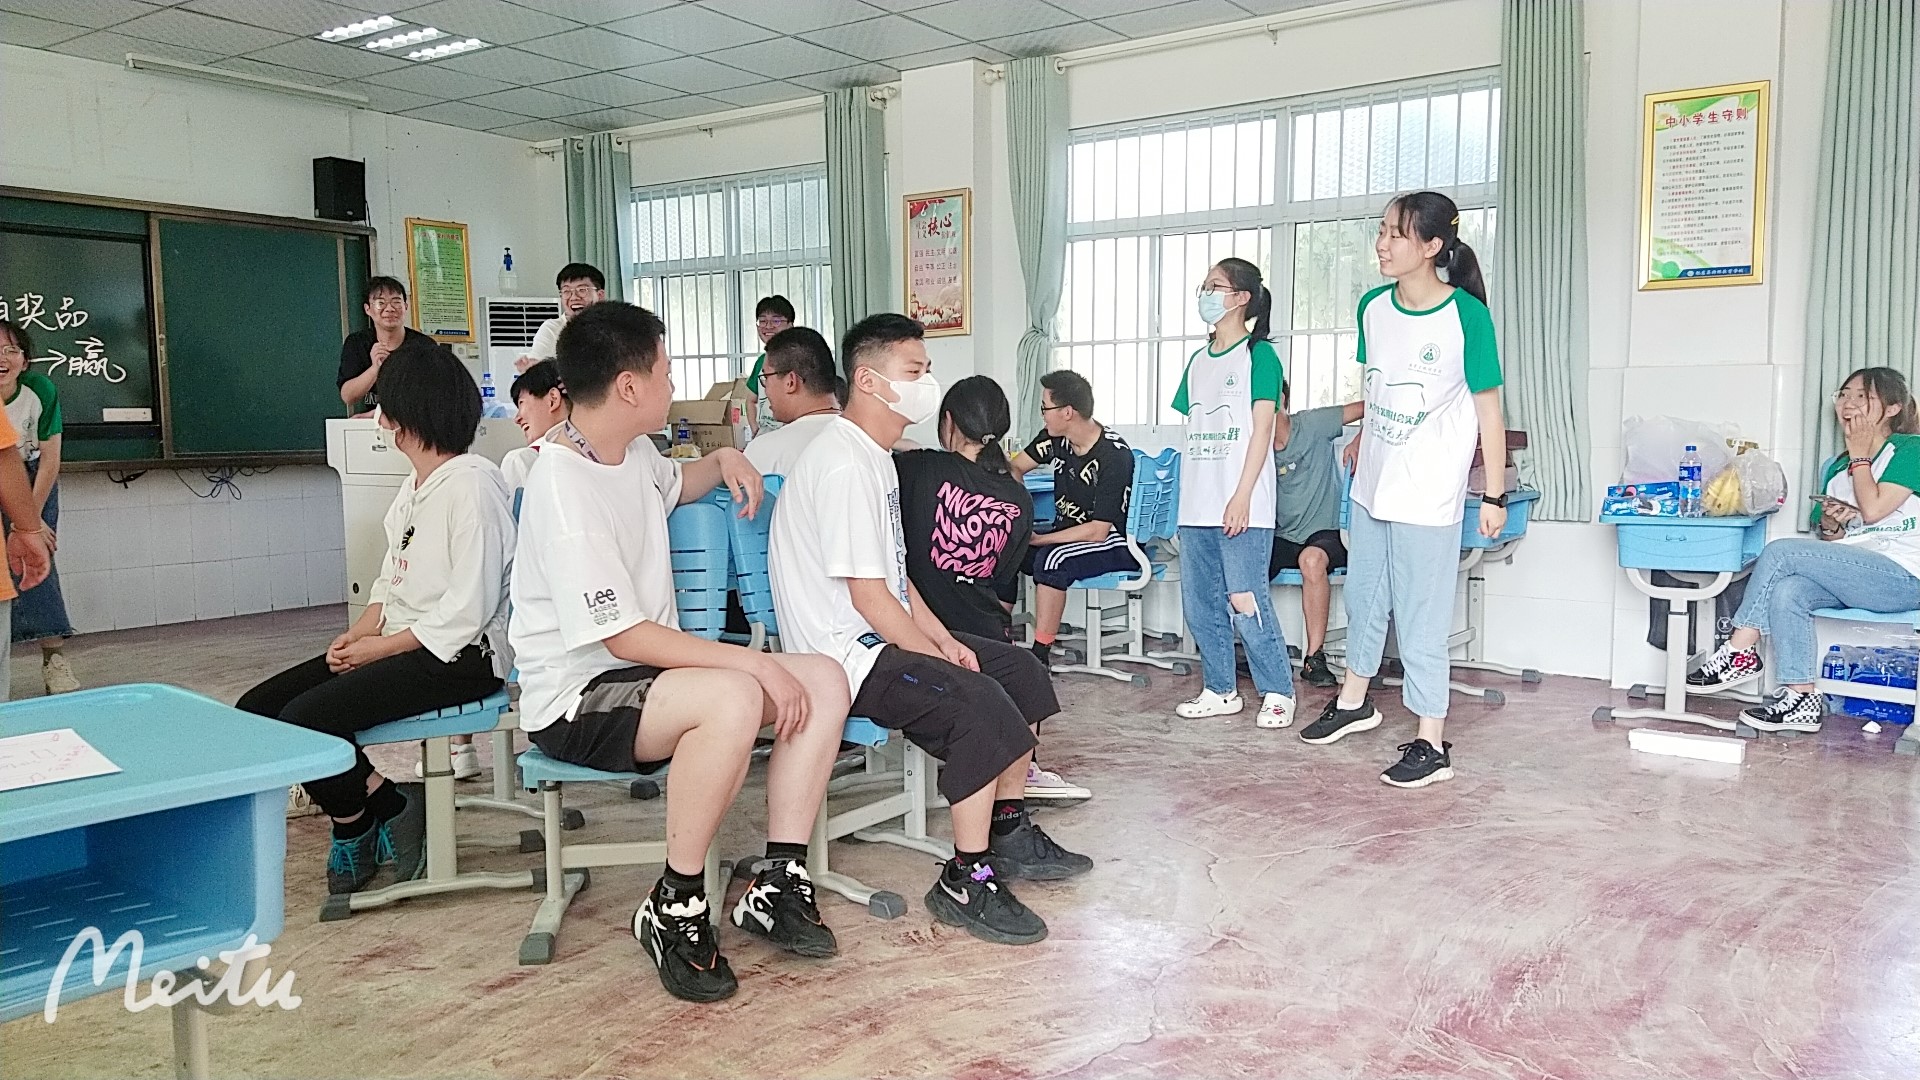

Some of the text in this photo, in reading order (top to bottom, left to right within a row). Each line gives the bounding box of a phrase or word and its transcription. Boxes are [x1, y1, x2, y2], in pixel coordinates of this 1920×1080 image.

[1665, 107, 1748, 128] 中小学生守则
[927, 213, 952, 237] 核心
[0, 292, 88, 331] 奖品
[583, 589, 617, 609] Lee
